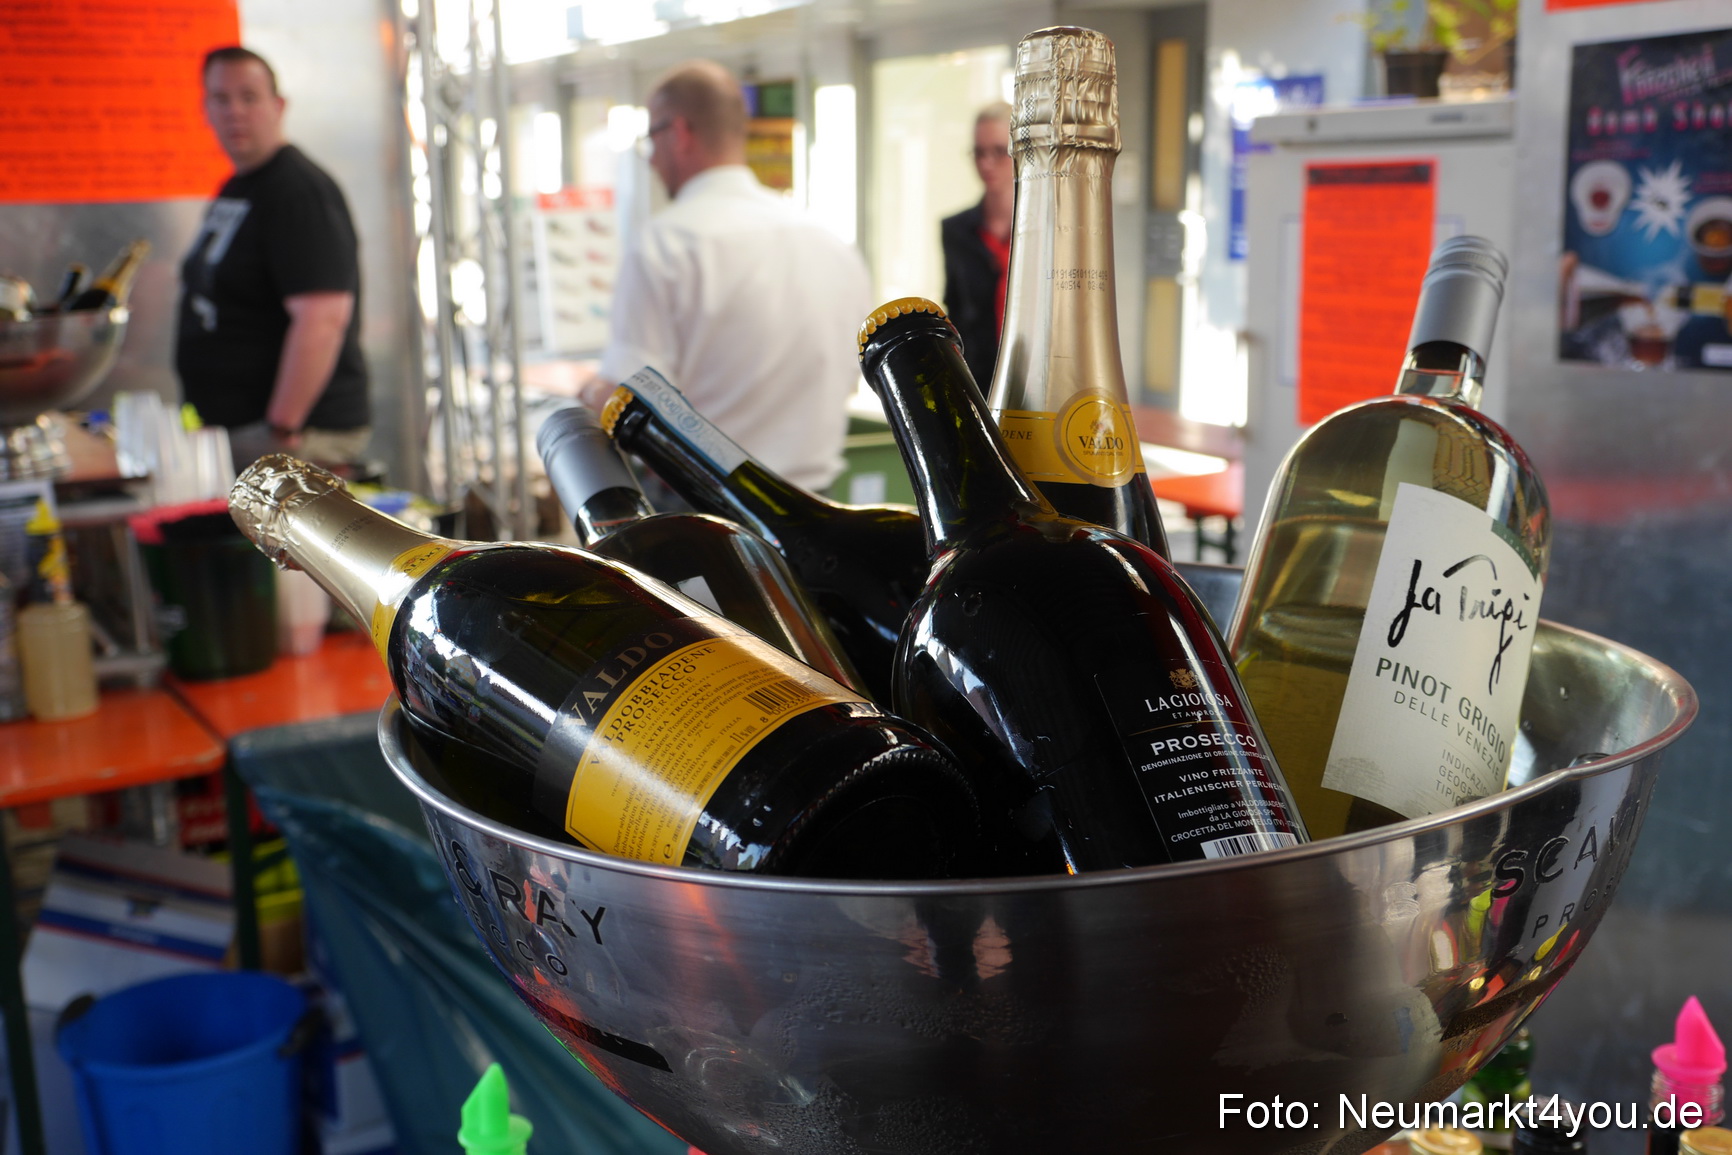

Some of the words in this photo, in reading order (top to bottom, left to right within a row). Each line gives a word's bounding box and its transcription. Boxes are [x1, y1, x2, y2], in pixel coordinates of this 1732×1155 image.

[1078, 435, 1124, 451] VALDO
[563, 632, 673, 727] VALDO
[590, 646, 716, 766] VALDOBBIADENE
[615, 664, 697, 743] PROSECCO
[633, 676, 696, 737] SUPERIORE
[1144, 696, 1170, 713] LA
[1170, 692, 1234, 708] GIOIOSA
[1375, 657, 1452, 704] PINOT
[1458, 696, 1506, 763] GRIGIO
[644, 720, 670, 750] EXTRA
[669, 682, 712, 719] TROCKEN
[659, 741, 673, 756] sich
[671, 728, 683, 741] aus
[682, 708, 703, 729] durch
[702, 694, 721, 710] einen
[721, 680, 744, 696] zarten
[666, 707, 693, 733] Prosecco
[674, 736, 687, 750] mit
[686, 718, 704, 737] einer
[703, 704, 719, 720] sehr
[718, 688, 745, 706] feinen,
[719, 715, 741, 736] ITALIA
[759, 715, 769, 724] 8
[1150, 733, 1257, 756] PROSECCO
[1393, 690, 1450, 728] DELLE
[1457, 722, 1500, 781] VENEZIE
[681, 757, 691, 769] DA
[691, 759, 708, 780] ITALIA
[1141, 753, 1203, 772] DENOMINAZIONE
[1213, 750, 1239, 758] ORIGINE
[1178, 771, 1209, 783] VINO
[1212, 767, 1265, 777] FRIZZANTE
[1439, 765, 1476, 796] GEOGR
[1154, 780, 1243, 803] ITALIENISCHER
[1177, 802, 1229, 819] Imbottigliato
[1208, 814, 1220, 823] da
[1220, 812, 1232, 820] LA
[1263, 809, 1276, 817] SPA
[1170, 825, 1217, 843] CROCETTA
[1217, 823, 1235, 832] DEL
[1234, 817, 1273, 828] MONTELLO
[488, 867, 607, 945] RAY
